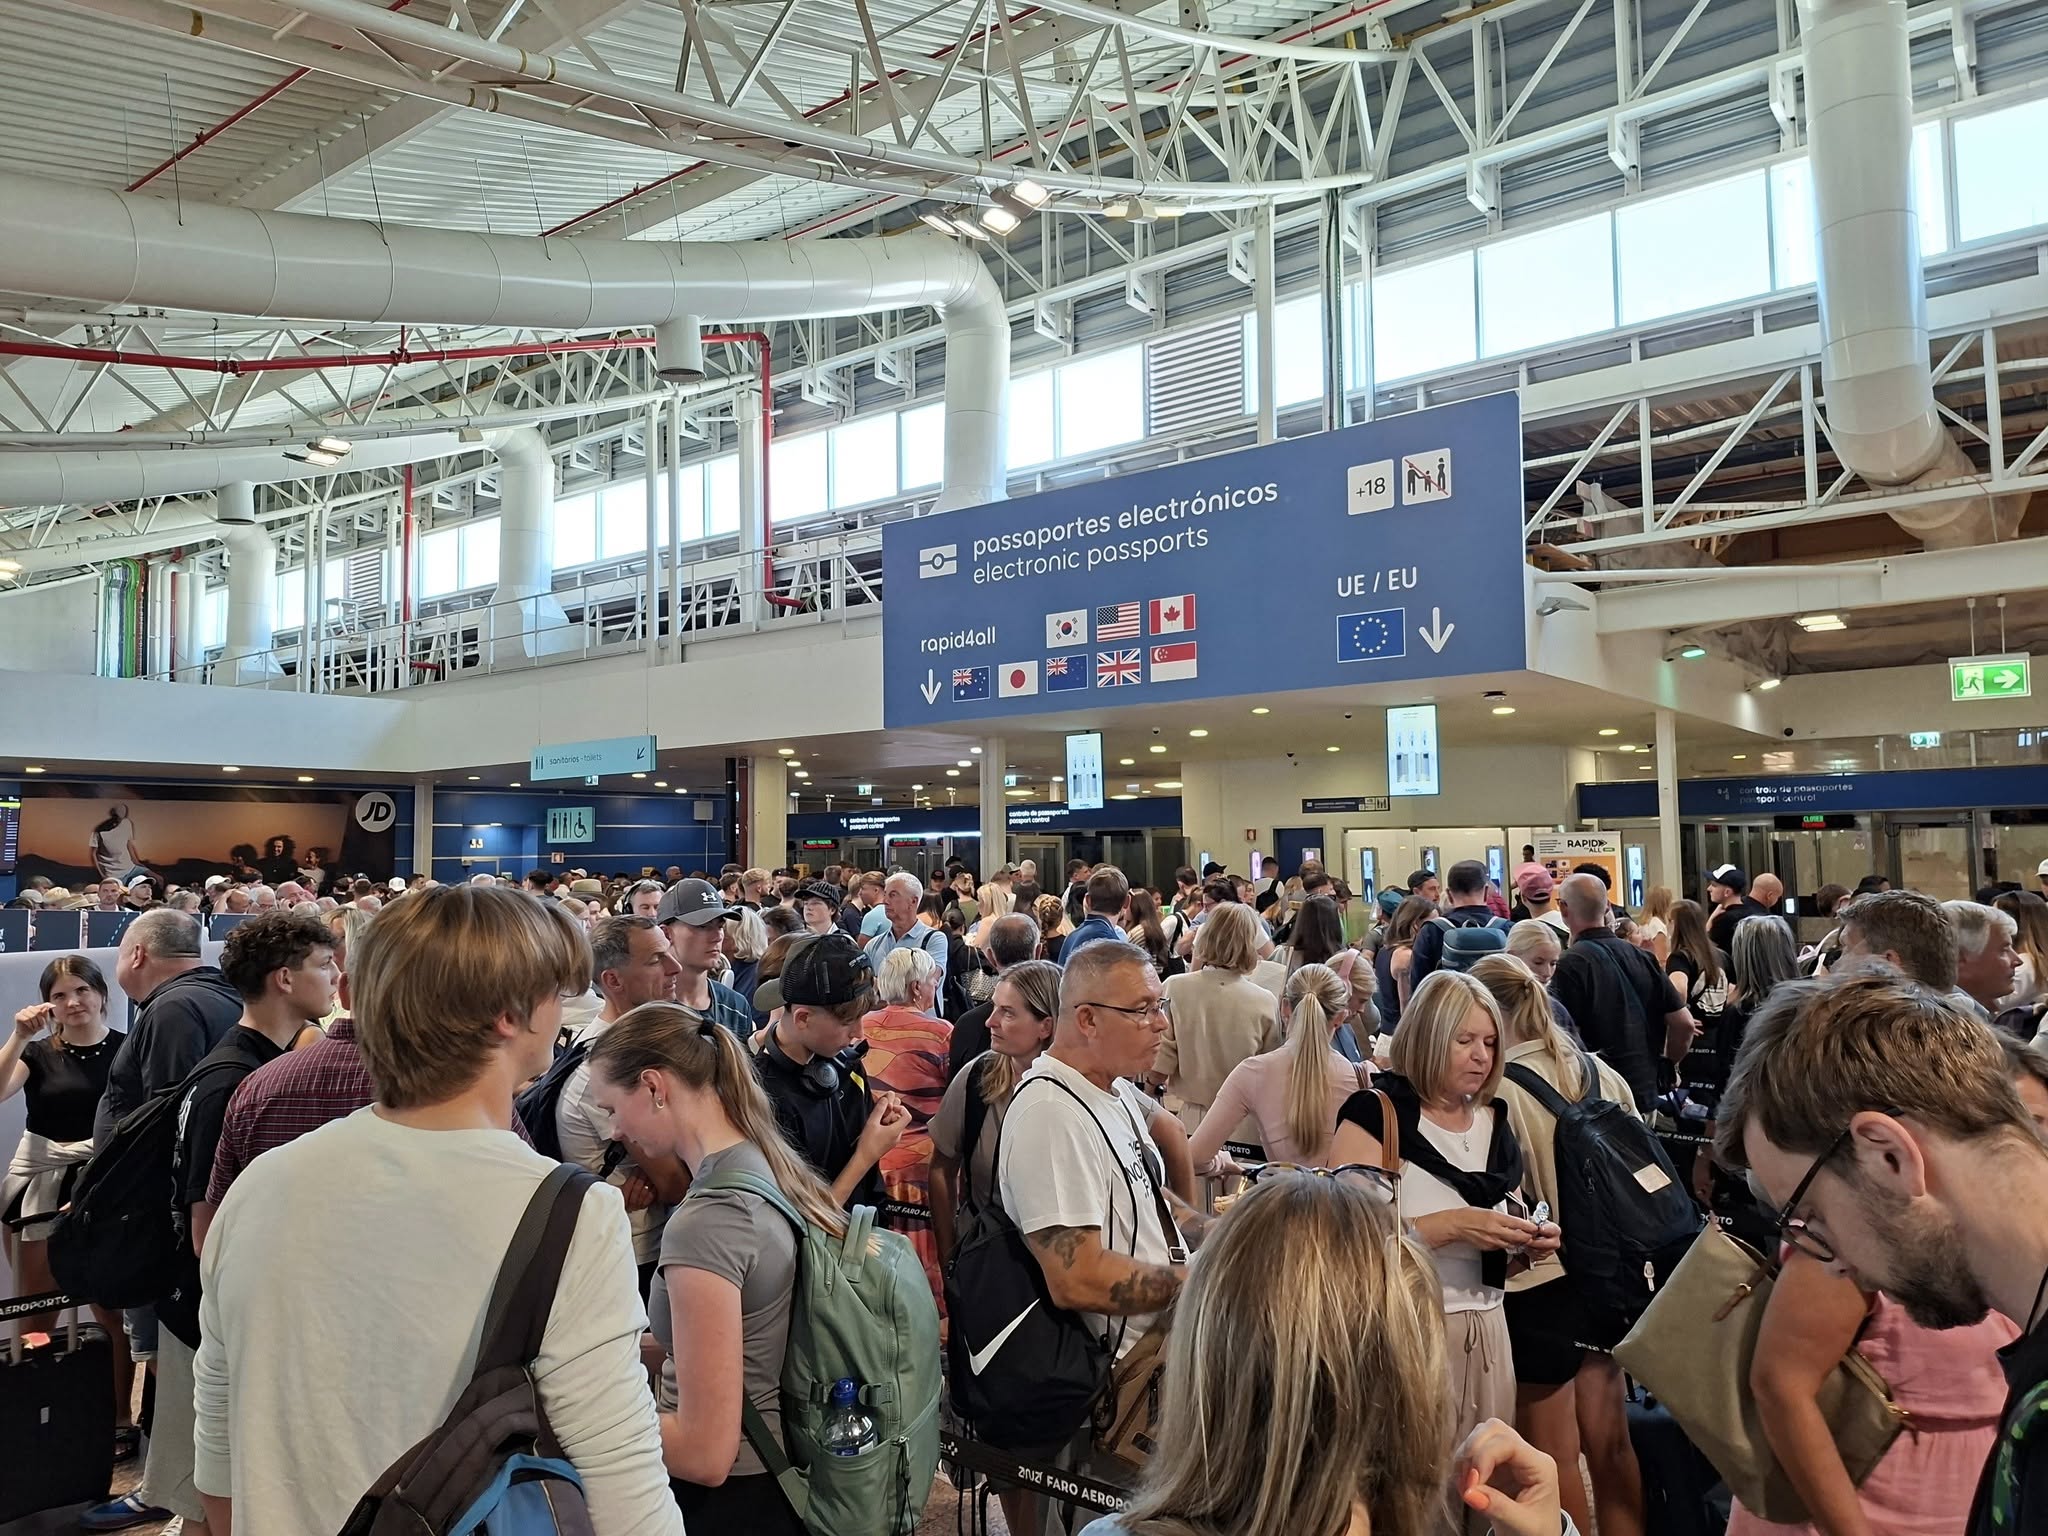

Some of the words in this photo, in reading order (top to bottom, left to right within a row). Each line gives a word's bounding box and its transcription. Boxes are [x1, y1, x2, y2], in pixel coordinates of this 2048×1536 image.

[1356, 477, 1386, 498] +18
[973, 513, 1111, 562] passaportes
[1117, 481, 1279, 529] electrónicos
[973, 548, 1081, 584] electronic
[1087, 526, 1209, 571] passports
[1337, 574, 1366, 597] UE
[1388, 566, 1418, 591] EU
[920, 625, 996, 656] rapid4all
[1793, 783, 1854, 794] passaportes
[361, 801, 392, 822] JD
[1567, 839, 1599, 848] RAPID
[901, 1206, 921, 1216] FARO
[1046, 1475, 1079, 1497] FARO
